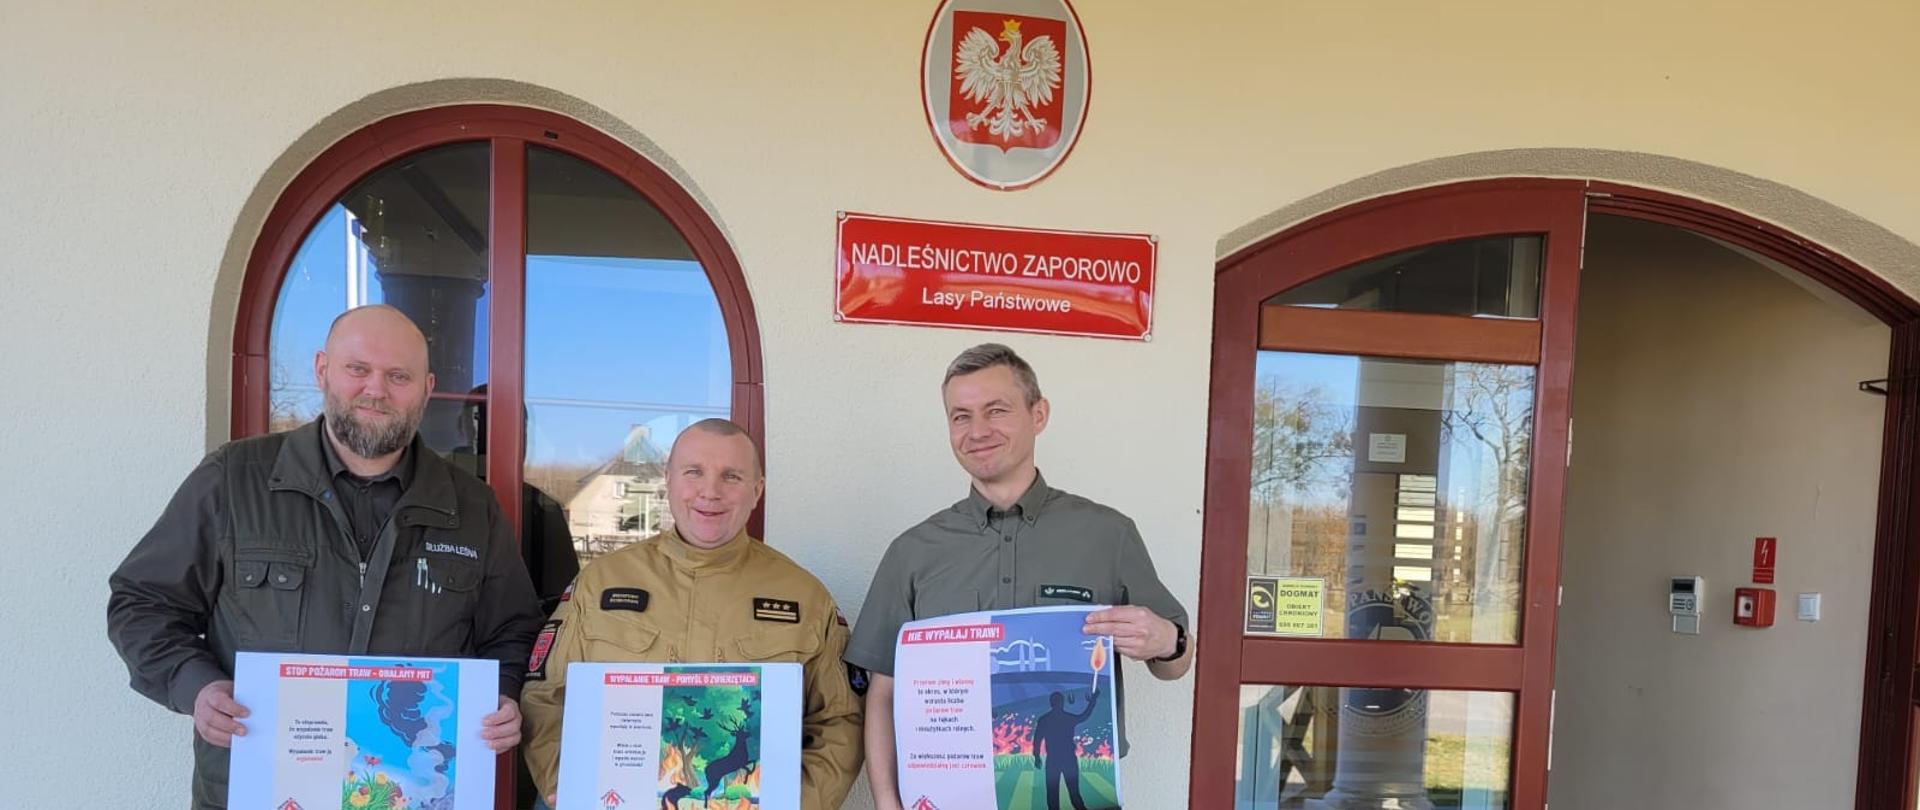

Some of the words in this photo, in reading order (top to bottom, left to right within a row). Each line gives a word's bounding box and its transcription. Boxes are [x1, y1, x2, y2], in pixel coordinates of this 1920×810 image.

[851, 242, 1018, 276] NADLEŚNICTWO
[1022, 253, 1141, 284] ZAPOROWO
[922, 287, 964, 309] Lasy
[970, 290, 1072, 313] Państwowe
[1280, 590, 1319, 598] DOGMAT
[907, 630, 923, 641] NIE
[925, 628, 968, 641] WYPALAJ
[969, 627, 1000, 639] TRAW!
[285, 665, 307, 676] STOP
[349, 667, 372, 678] TRAW
[416, 669, 431, 679] MIT
